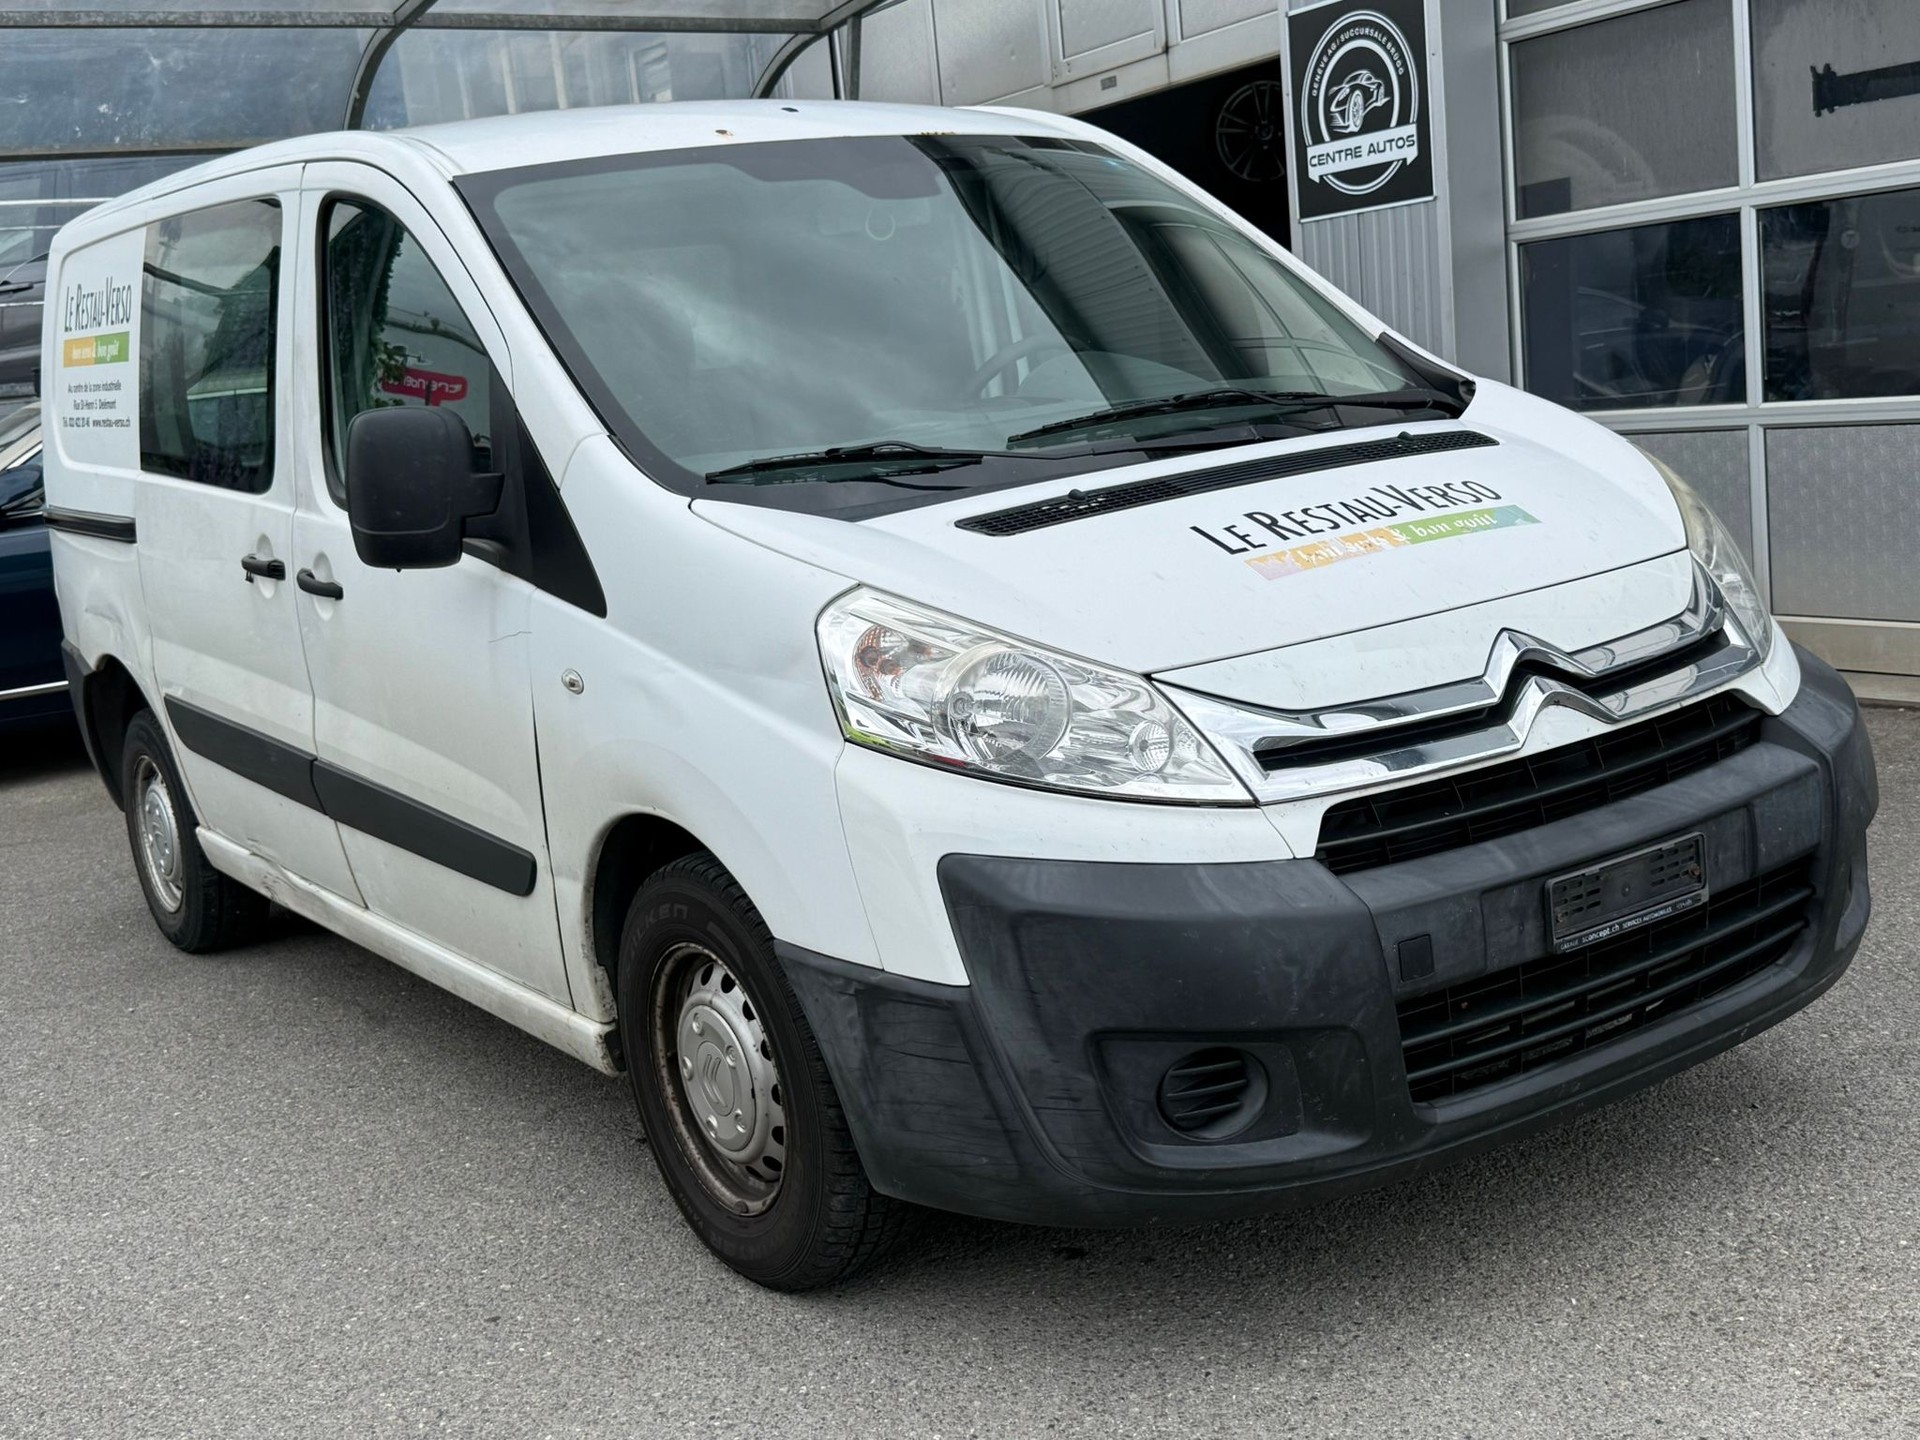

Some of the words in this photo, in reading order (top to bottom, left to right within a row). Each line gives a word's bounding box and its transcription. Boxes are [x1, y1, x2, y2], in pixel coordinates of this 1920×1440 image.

[1327, 42, 1338, 57] AG
[1340, 27, 1388, 45] SUCCURSALE
[1309, 146, 1362, 168] CENTRE
[1367, 134, 1416, 157] AUTOS
[64, 286, 75, 333] LE
[75, 276, 132, 331] RESTAU-VERSO
[1189, 525, 1268, 555] LE
[1243, 480, 1503, 541] RESTAU-VERSO
[1408, 524, 1453, 537] bon
